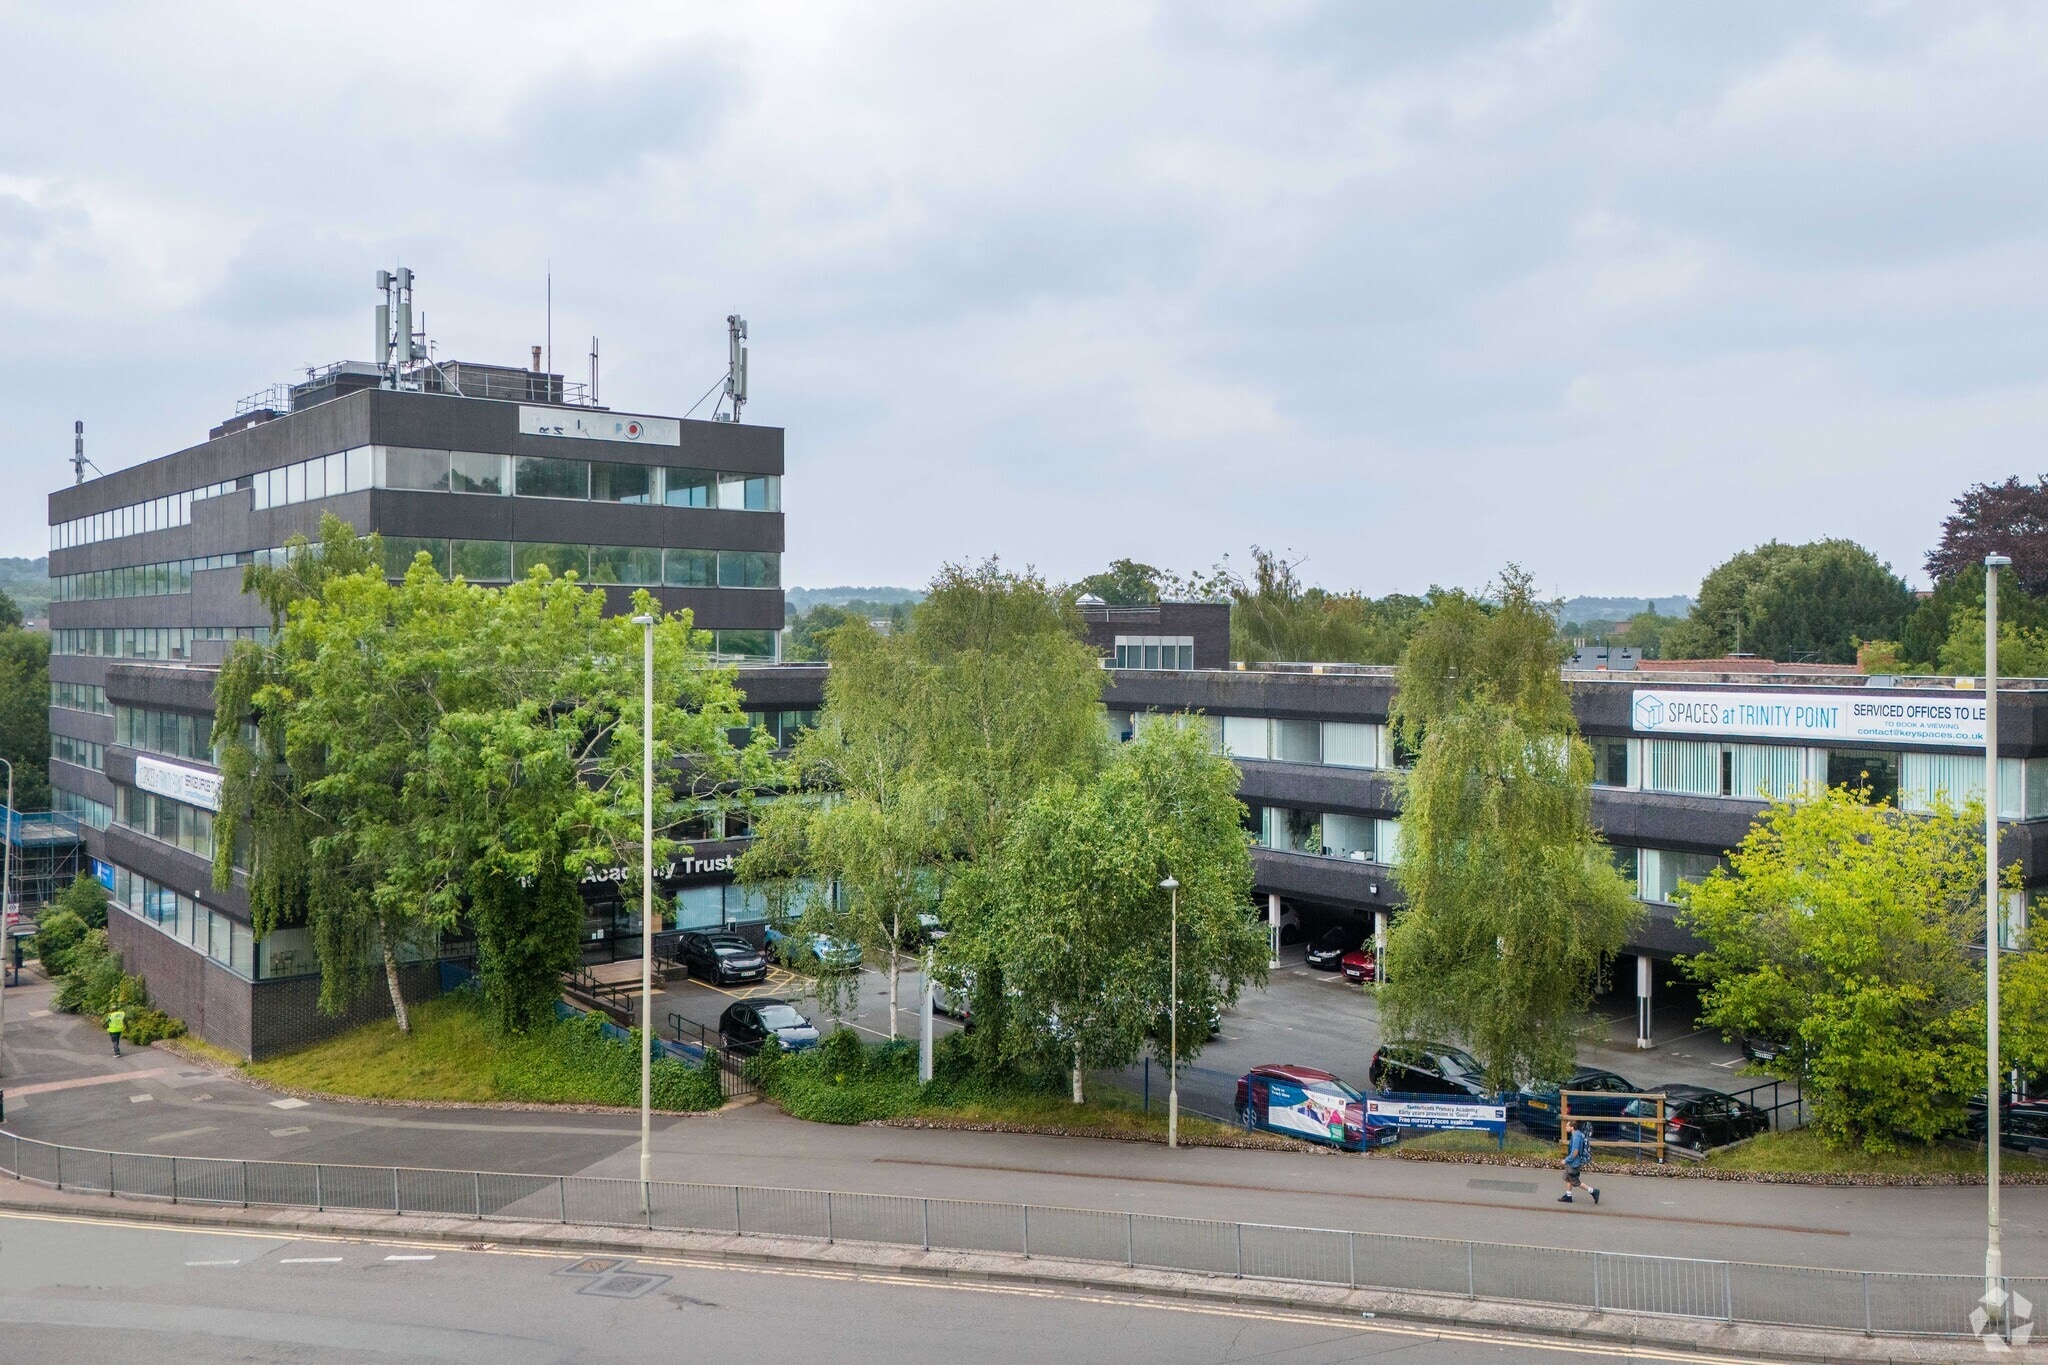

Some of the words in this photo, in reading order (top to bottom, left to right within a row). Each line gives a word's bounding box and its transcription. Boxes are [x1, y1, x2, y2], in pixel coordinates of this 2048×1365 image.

[1669, 703, 1718, 724] SPACES
[1723, 709, 1735, 724] at
[1739, 704, 1791, 727] TRINITY
[1796, 706, 1839, 729] POINT
[1853, 703, 1904, 718] SERVICED
[1906, 705, 1952, 719] OFFICES
[1954, 707, 1970, 720] TO
[1972, 708, 1986, 721] LE
[1857, 728, 1983, 740] contact@keyspaces.co.uk
[682, 854, 733, 874] Trust
